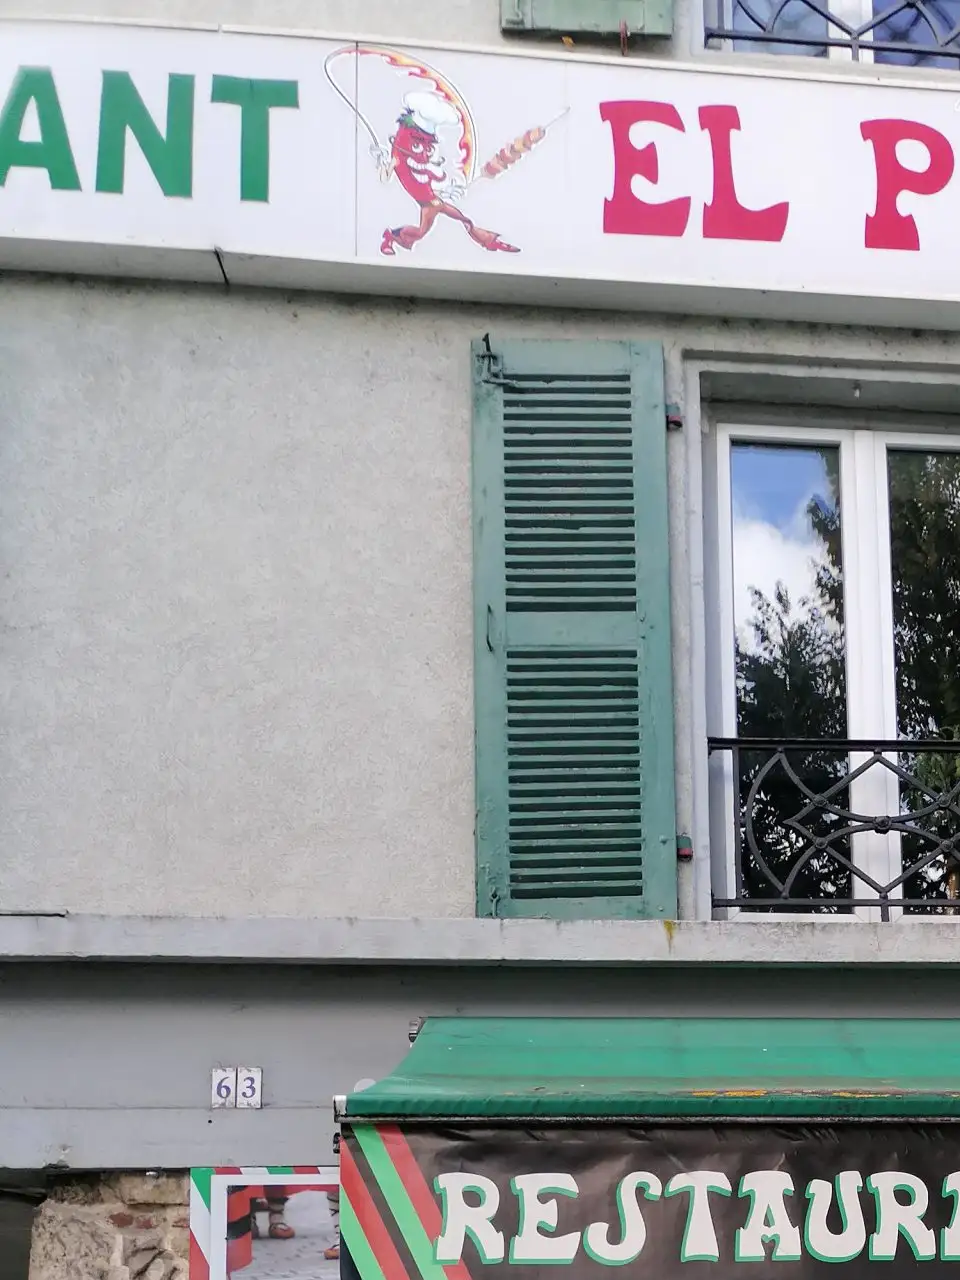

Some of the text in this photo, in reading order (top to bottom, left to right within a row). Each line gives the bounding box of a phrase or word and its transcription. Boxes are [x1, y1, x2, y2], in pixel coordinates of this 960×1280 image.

[0, 65, 299, 203] ANT
[600, 100, 789, 243] EL
[216, 1076, 256, 1098] 63
